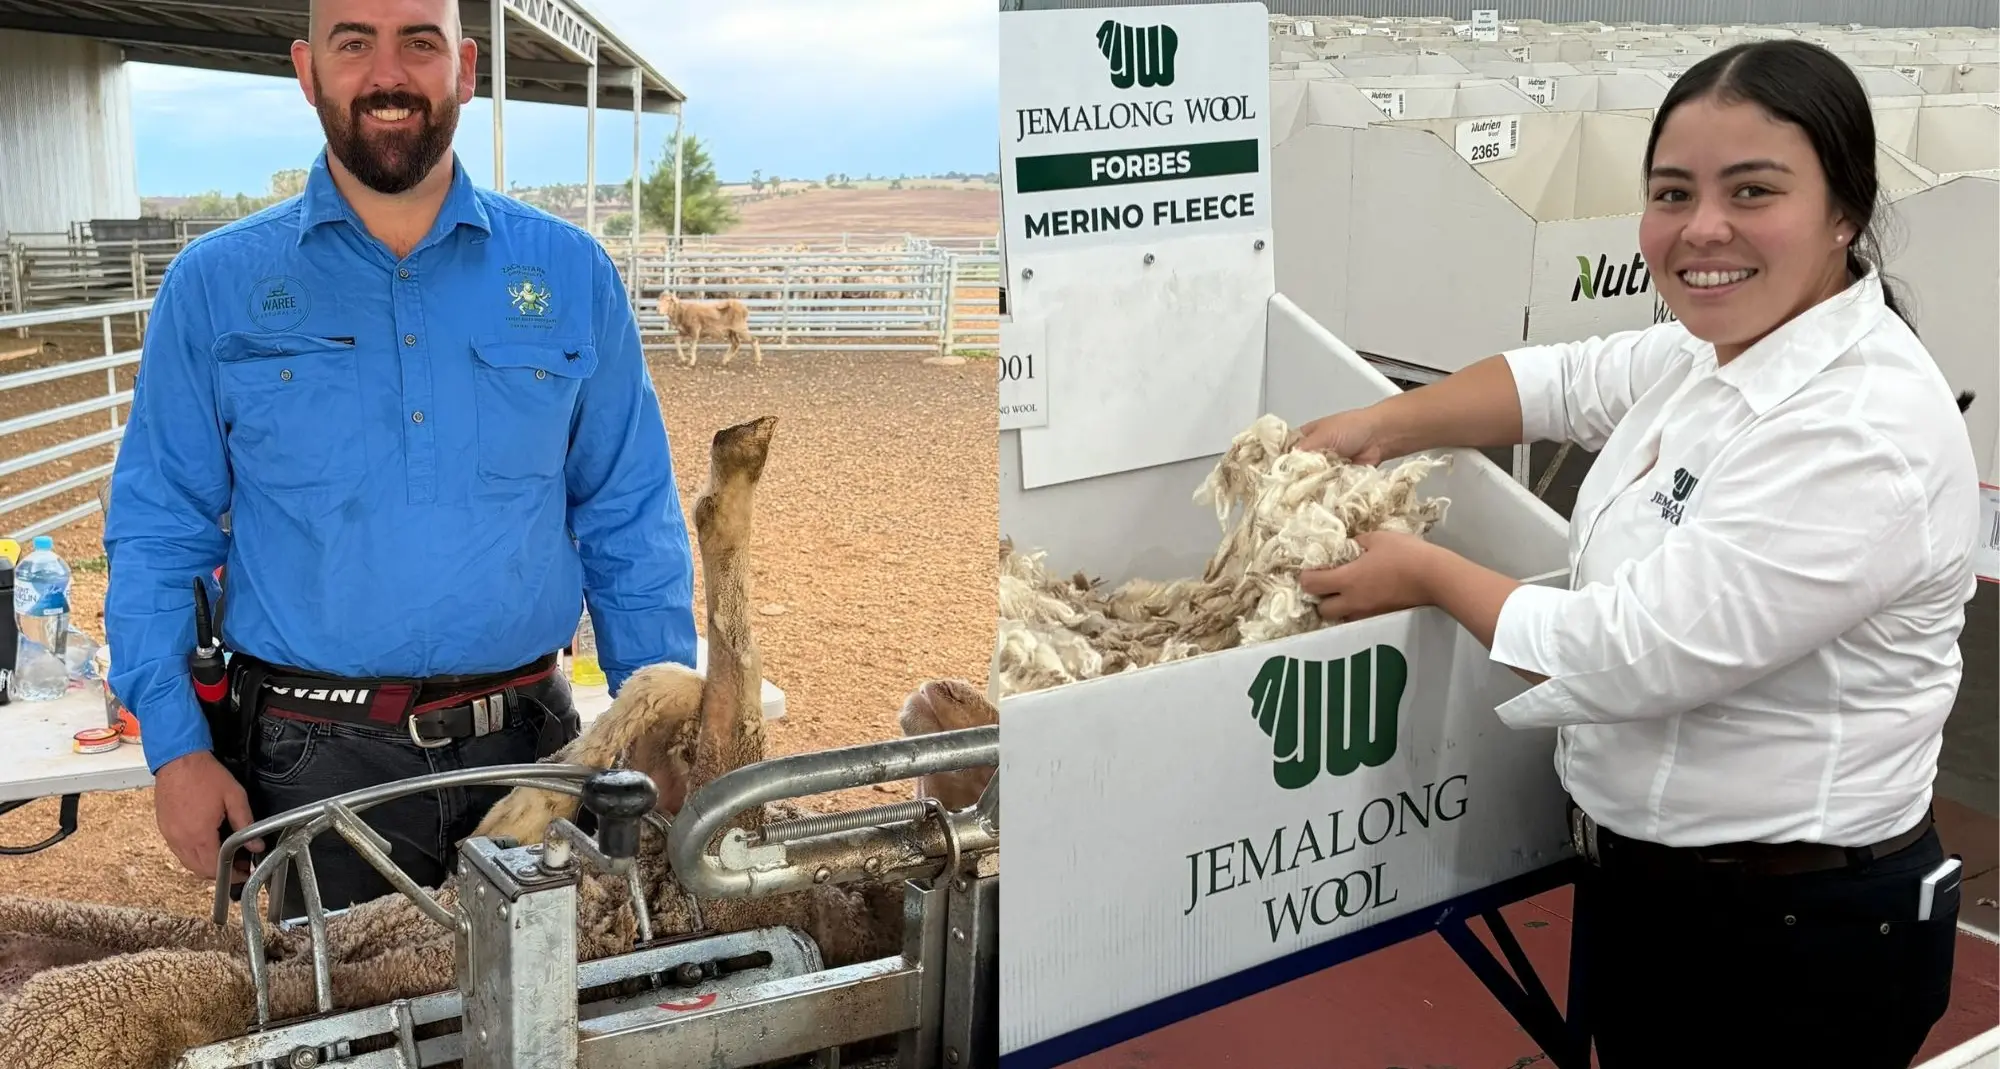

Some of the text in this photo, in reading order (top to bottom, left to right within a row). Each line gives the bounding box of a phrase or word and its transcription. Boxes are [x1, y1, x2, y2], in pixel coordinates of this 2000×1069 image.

[1016, 95, 1256, 142] JEMALONG WOOL
[1471, 119, 1501, 132] Nutrien
[1091, 151, 1191, 181] FORBES
[1472, 142, 1499, 160] 2365
[1025, 193, 1255, 239] MERINO FLEECE
[262, 296, 296, 311] WAREE
[1012, 404, 1037, 414] WOOL
[1184, 775, 1469, 915] JEMALONG
[1262, 862, 1398, 944] WOOL
